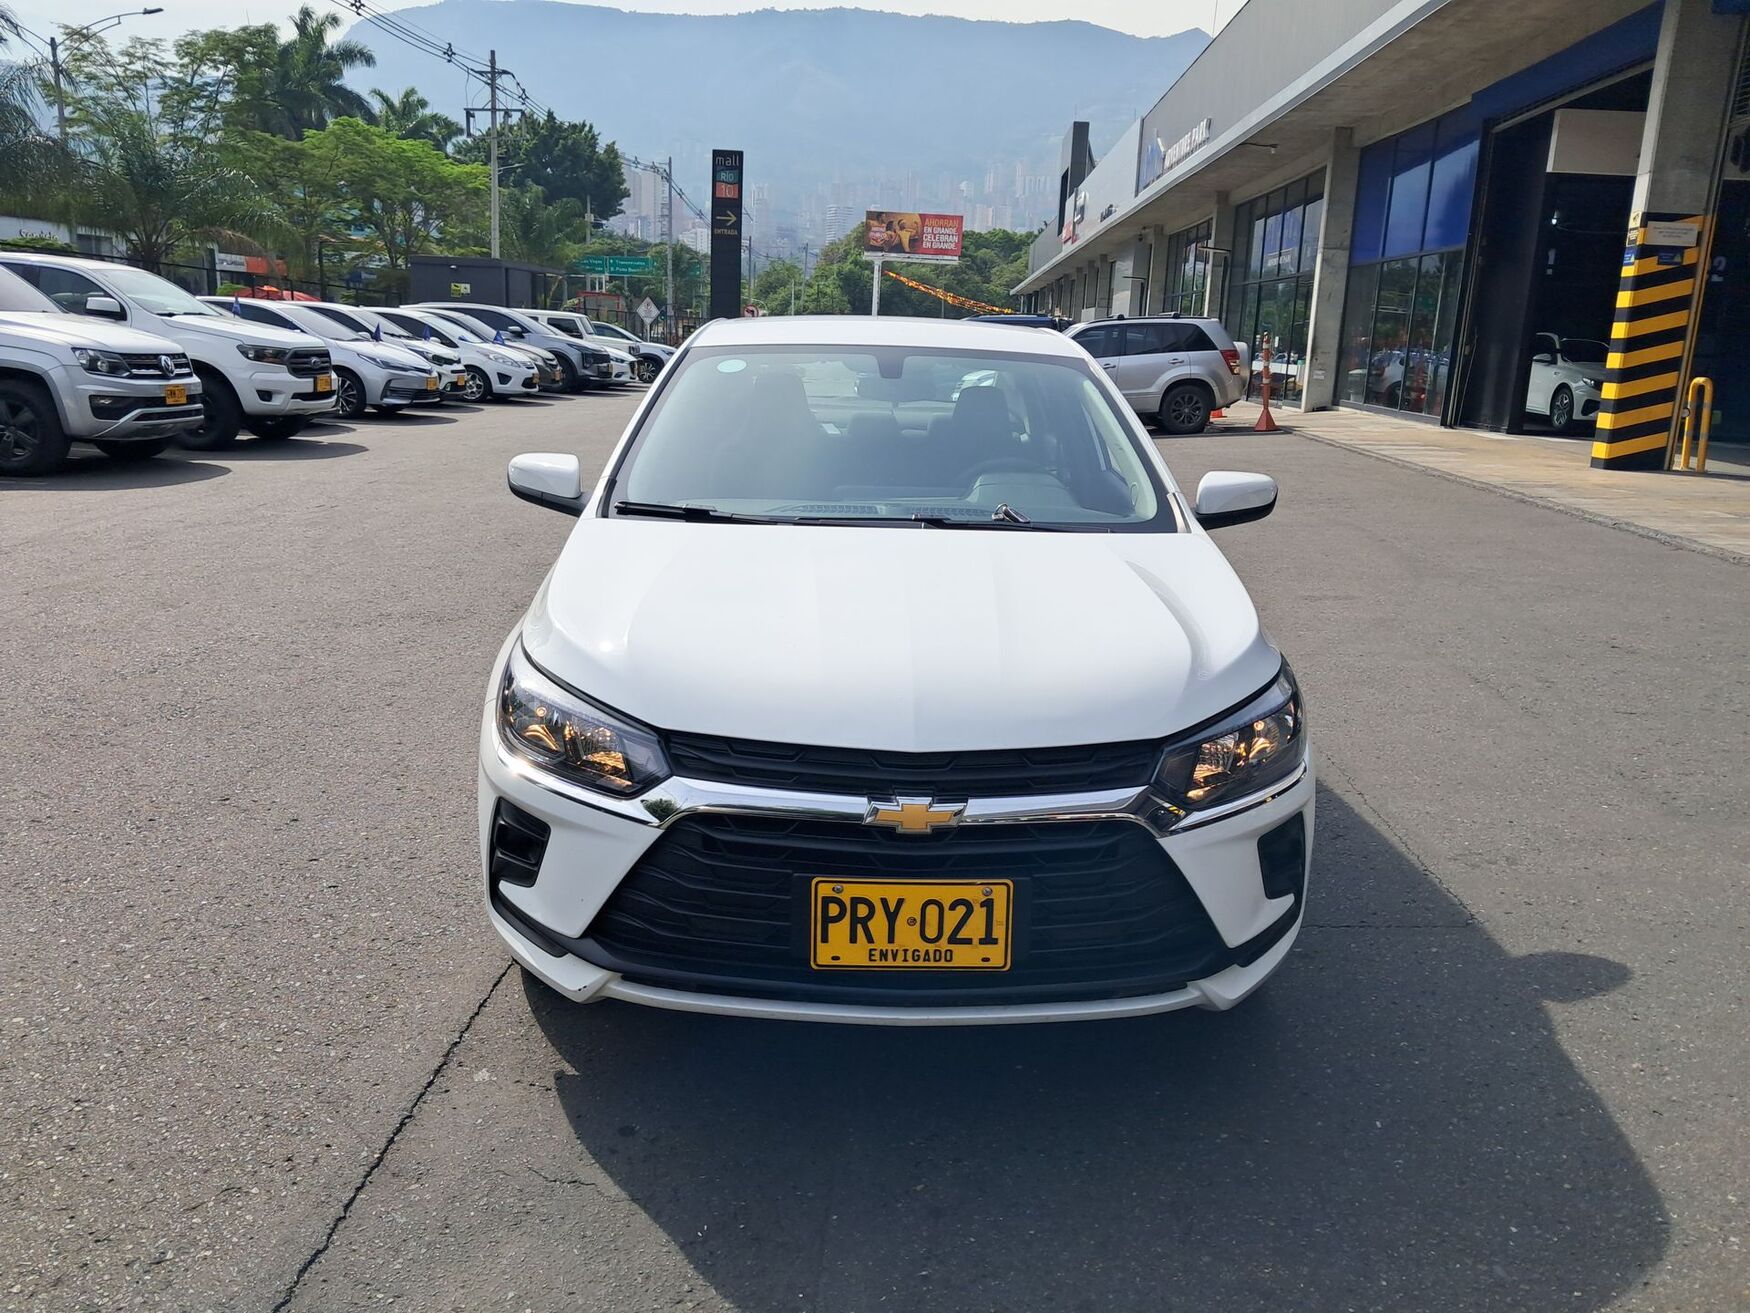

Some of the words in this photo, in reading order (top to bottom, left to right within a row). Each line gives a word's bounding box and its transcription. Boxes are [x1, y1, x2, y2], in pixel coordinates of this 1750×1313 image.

[715, 154, 740, 167] mall
[924, 218, 959, 228] AHORRAN
[923, 233, 958, 243] CELEBRAN
[820, 895, 905, 945] PRY
[918, 897, 1000, 946] 021
[868, 948, 954, 963] ENVIGADO
